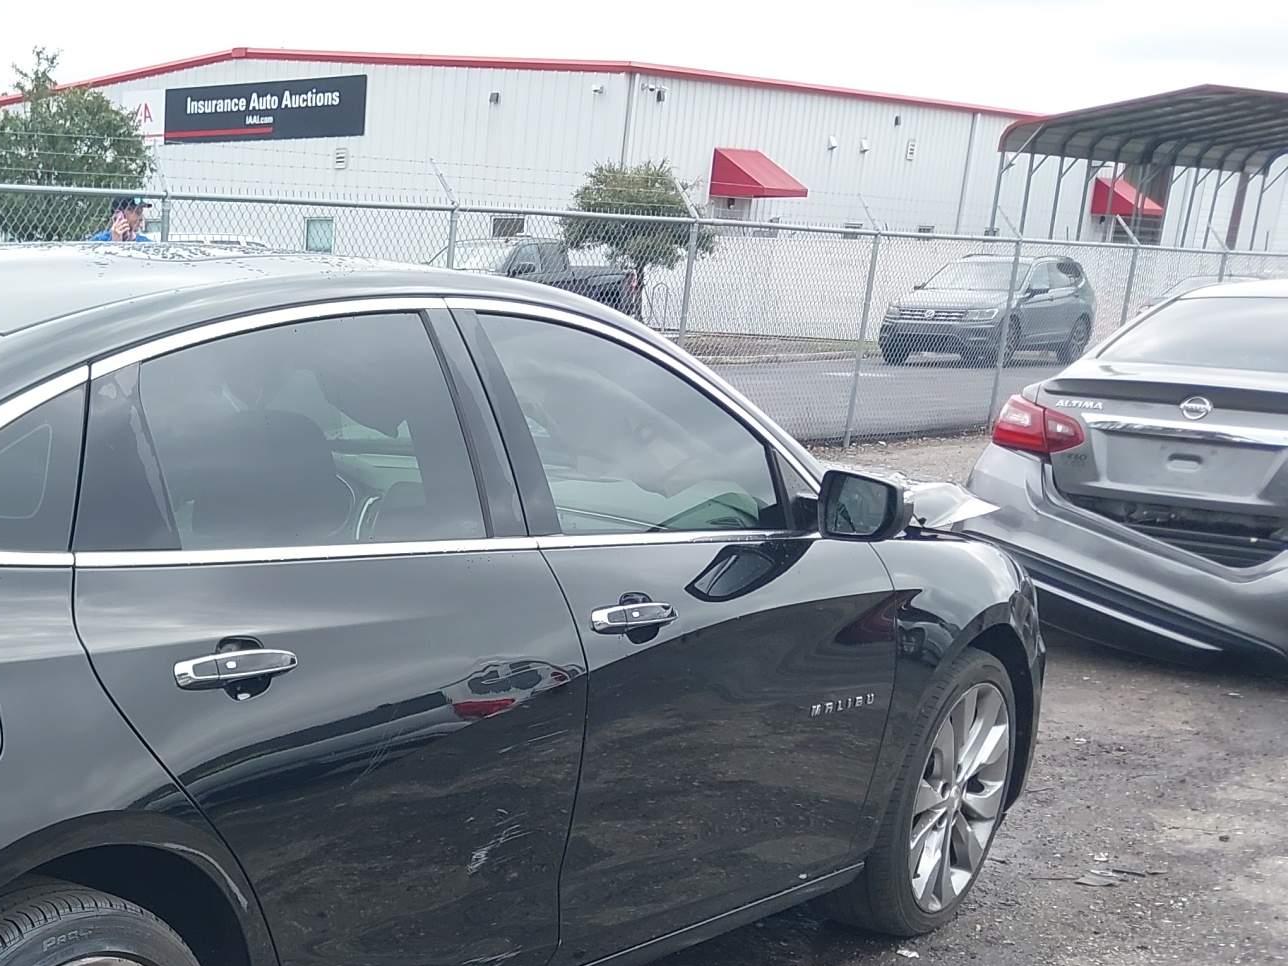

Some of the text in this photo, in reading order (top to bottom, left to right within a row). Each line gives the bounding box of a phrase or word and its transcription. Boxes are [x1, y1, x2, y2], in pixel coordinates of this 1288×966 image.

[186, 88, 340, 114] Insurance Auto Auctions
[1055, 399, 1103, 410] ALTIMA
[811, 693, 875, 717] MALIBU
